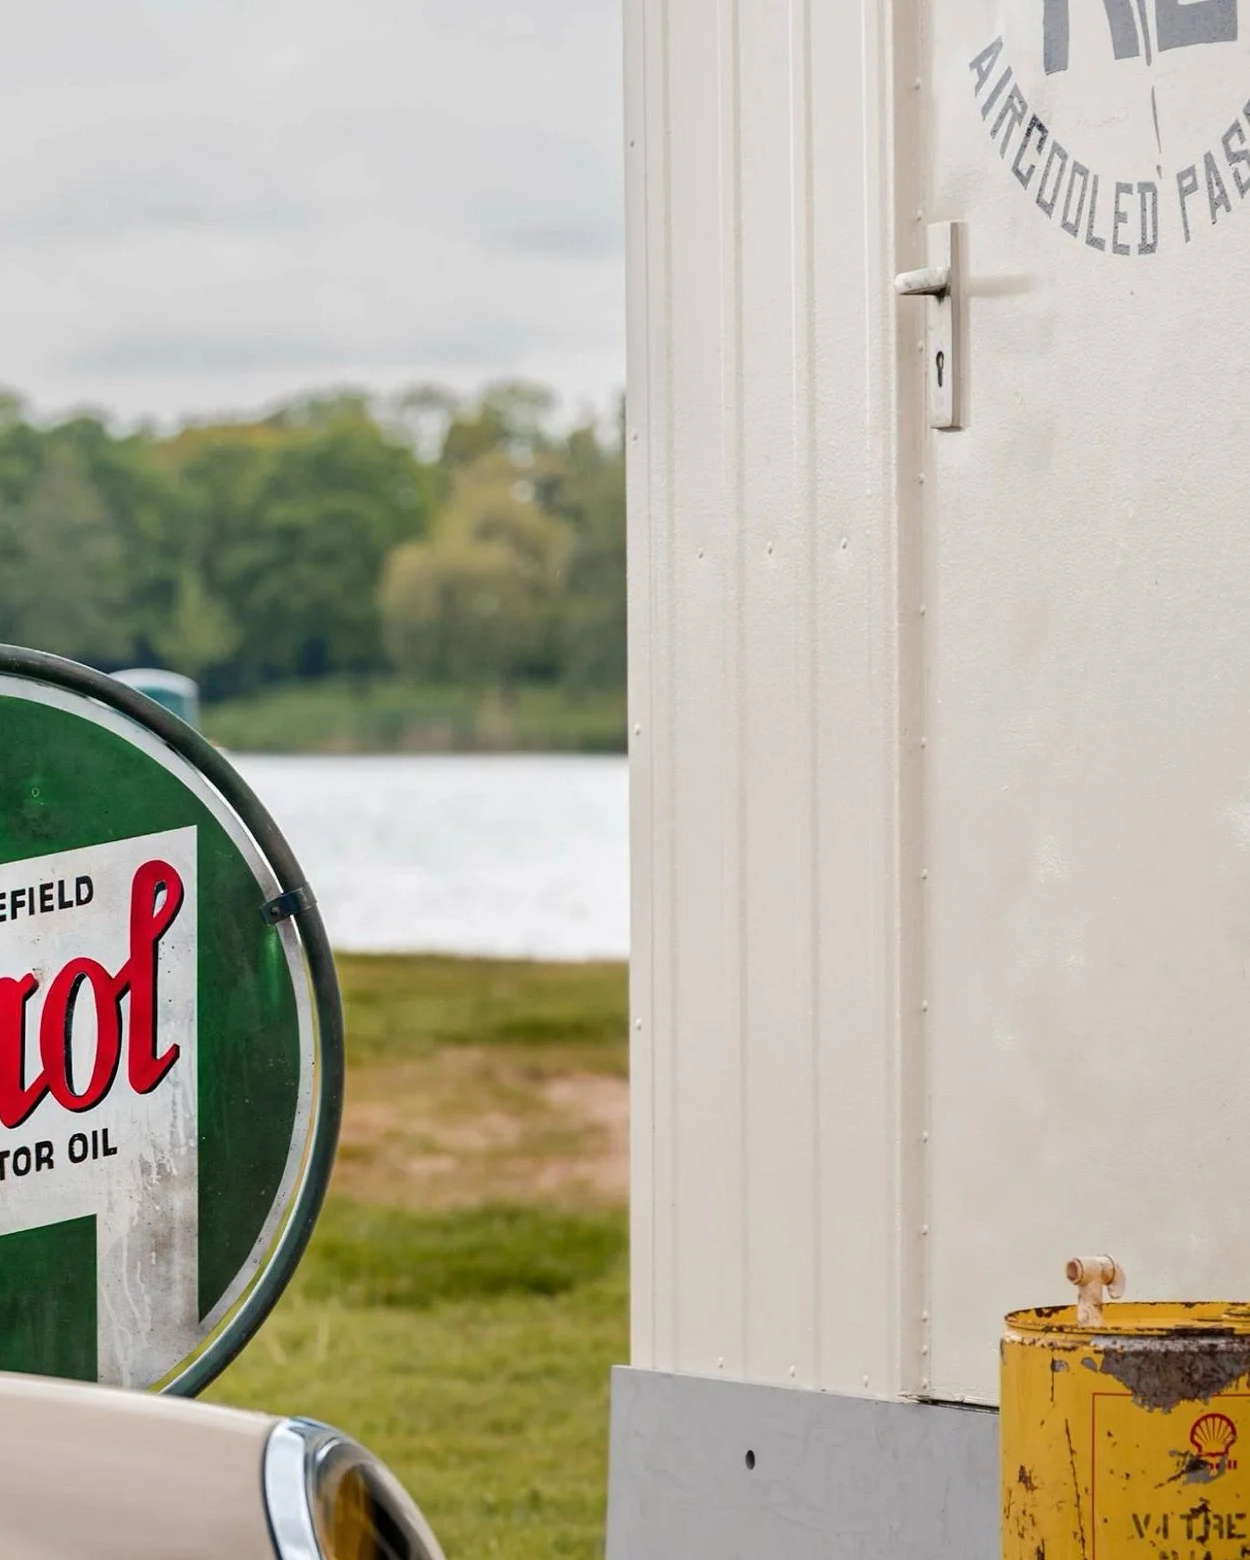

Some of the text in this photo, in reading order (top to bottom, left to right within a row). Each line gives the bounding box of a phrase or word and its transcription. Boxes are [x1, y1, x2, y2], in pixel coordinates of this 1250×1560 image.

[969, 35, 1159, 257] AIRCOOLED
[1175, 98, 1250, 244] PAS
[68, 1128, 118, 1164] OIL
